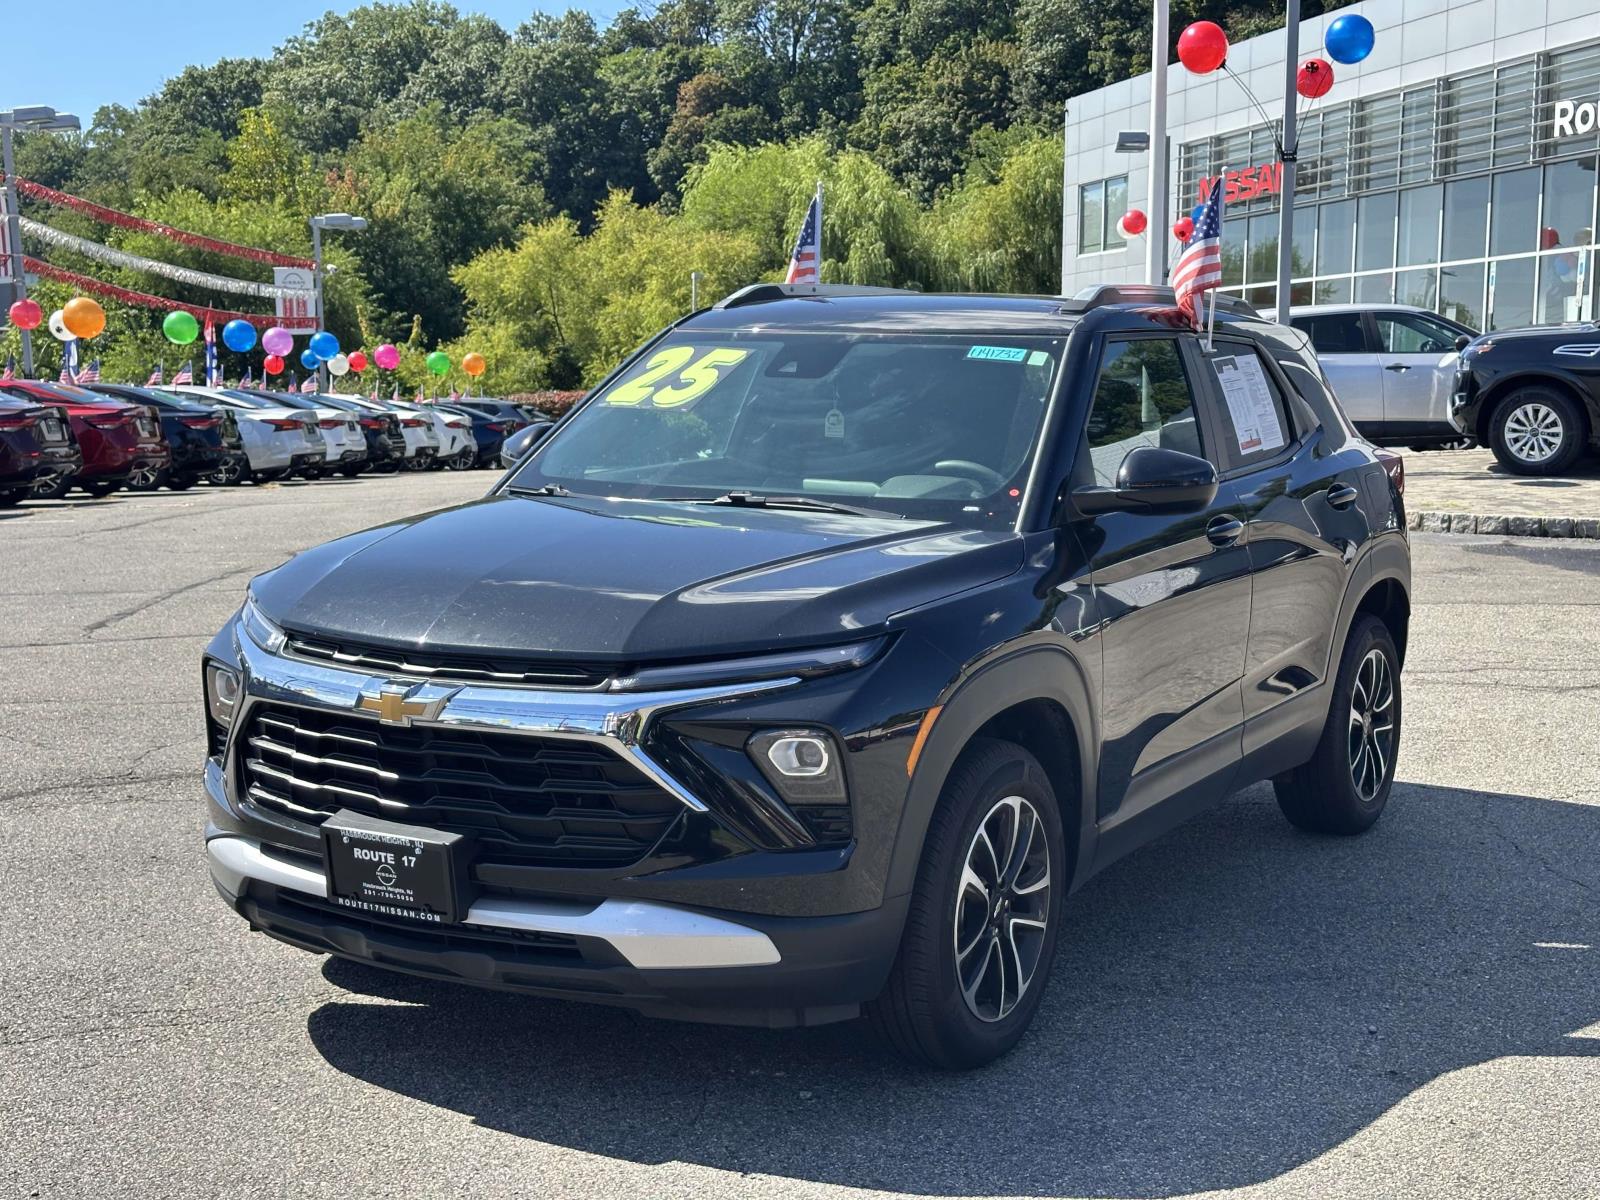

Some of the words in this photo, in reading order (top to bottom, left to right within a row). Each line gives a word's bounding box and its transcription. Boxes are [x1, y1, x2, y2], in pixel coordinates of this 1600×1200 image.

[1554, 100, 1600, 138] RO
[605, 346, 748, 408] 25
[353, 847, 395, 865] ROUTE
[401, 855, 417, 868] 17
[338, 897, 441, 922] ROUTE17NISSAN.COM
